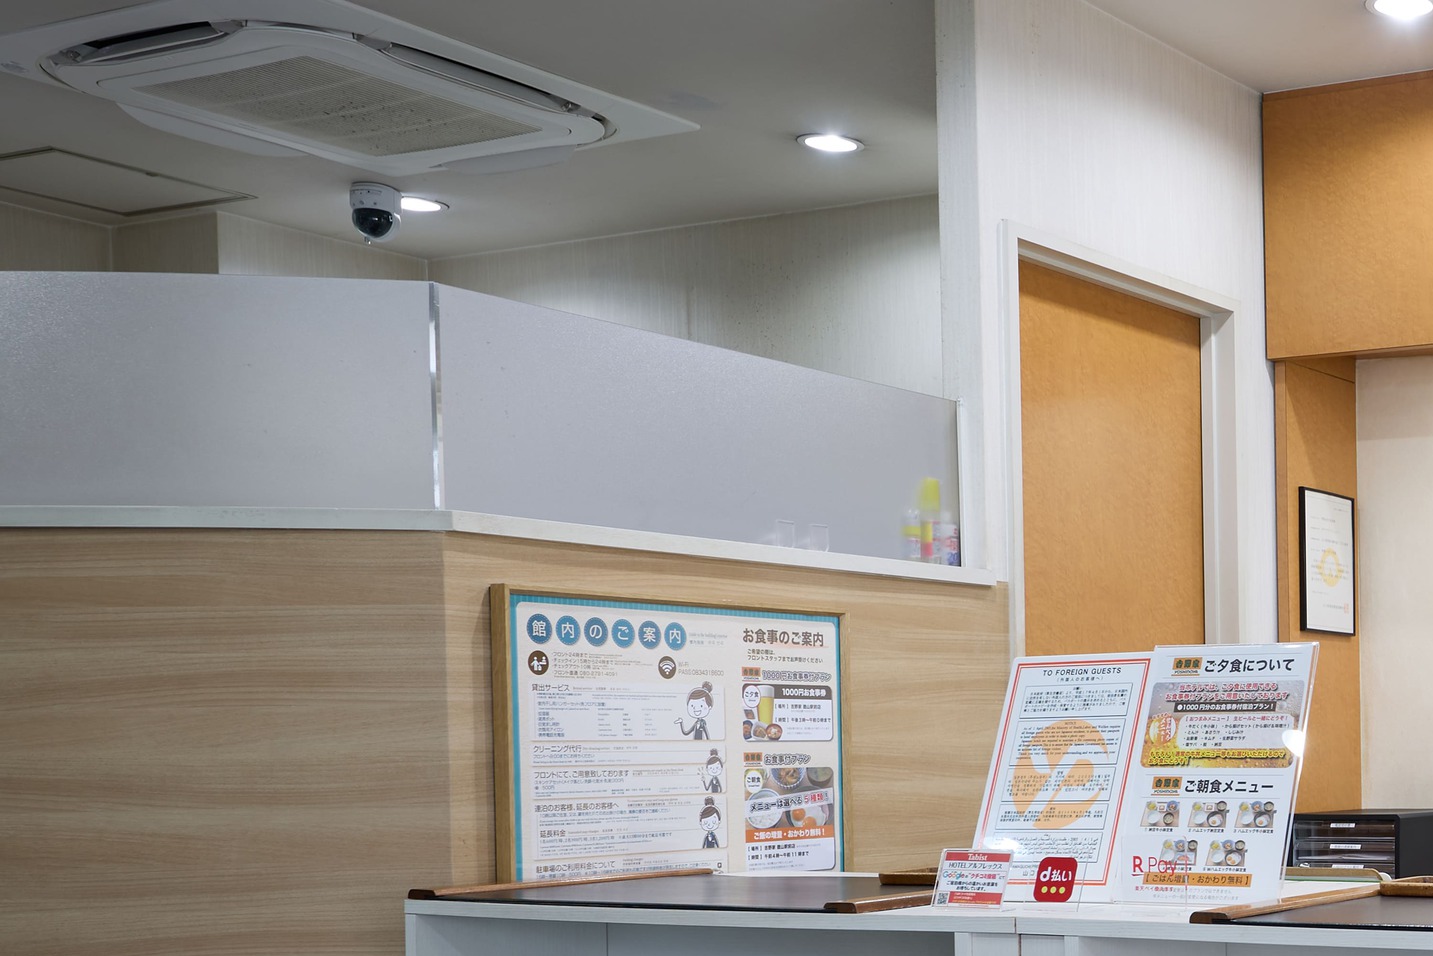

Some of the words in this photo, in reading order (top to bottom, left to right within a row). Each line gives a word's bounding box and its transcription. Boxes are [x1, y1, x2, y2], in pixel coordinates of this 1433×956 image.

[532, 620, 682, 644] 館内のご案内
[743, 628, 824, 647] お食事のご案内
[1042, 669, 1053, 677] TO
[1055, 668, 1089, 676] FOREIGN
[1091, 667, 1122, 675] GUESTS
[1204, 658, 1295, 673] ご夕食について
[531, 683, 570, 692] 貸出サービス
[782, 688, 826, 697] 1000円お食事券
[1184, 779, 1274, 794] ご朝食メニュー
[539, 829, 566, 838] 延長料金
[967, 853, 988, 861] Tabist
[1040, 866, 1072, 882] d払い
[1148, 857, 1178, 877] Pay
